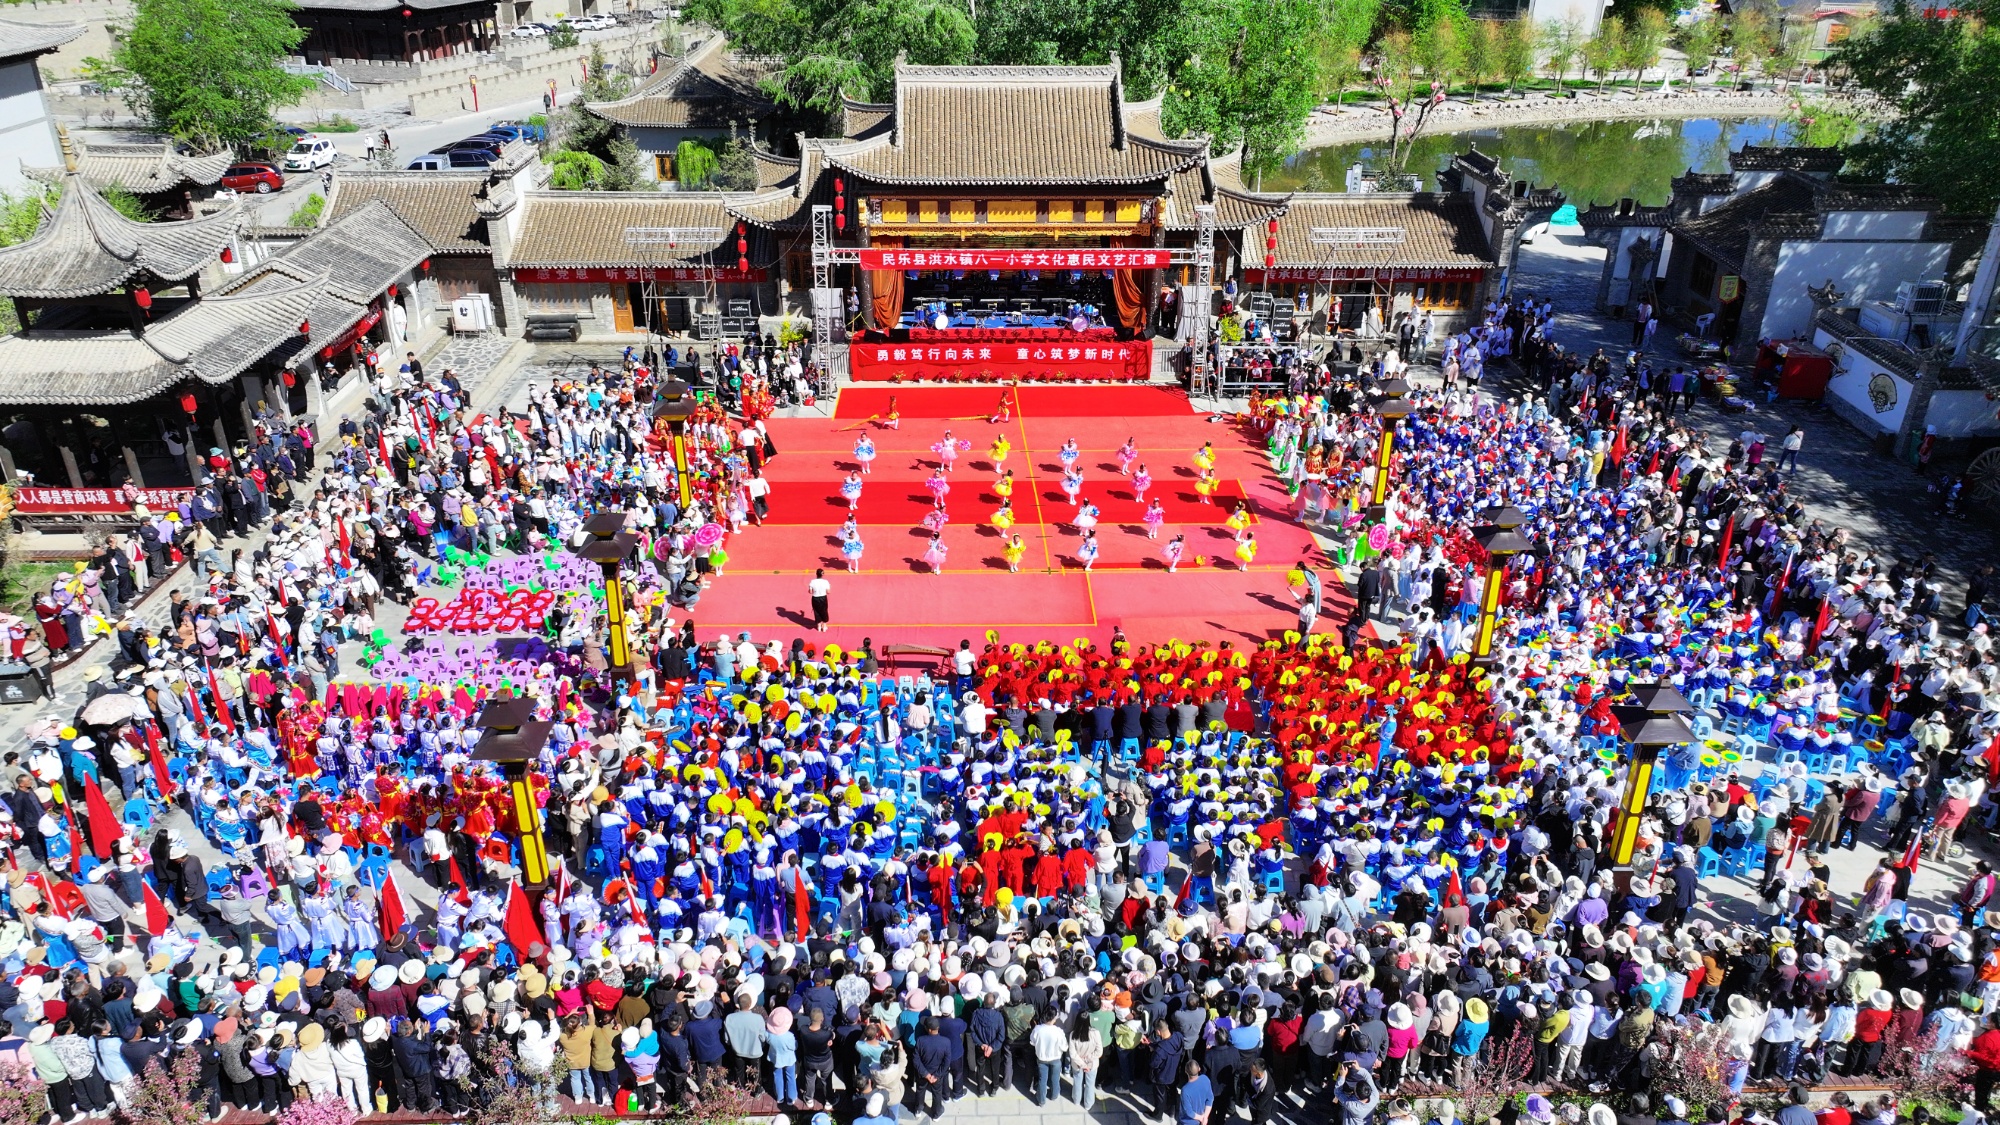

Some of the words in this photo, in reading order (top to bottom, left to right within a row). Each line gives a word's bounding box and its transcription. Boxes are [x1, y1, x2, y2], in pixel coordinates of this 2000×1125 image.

[882, 252, 1158, 267] 民乐县洪水镇八一小学文化惠民文艺汇演
[537, 268, 589, 280] 感党恩
[605, 268, 656, 280] 听党话
[674, 268, 725, 280] 跟党走
[1267, 269, 1347, 281] 传承红色基因
[1363, 268, 1446, 280] 厚植家国情怀
[876, 348, 992, 361] 勇毅笃行向未来
[1016, 348, 1131, 361] 童心筑梦新时代
[18, 489, 110, 505] 人人都是营商环境
